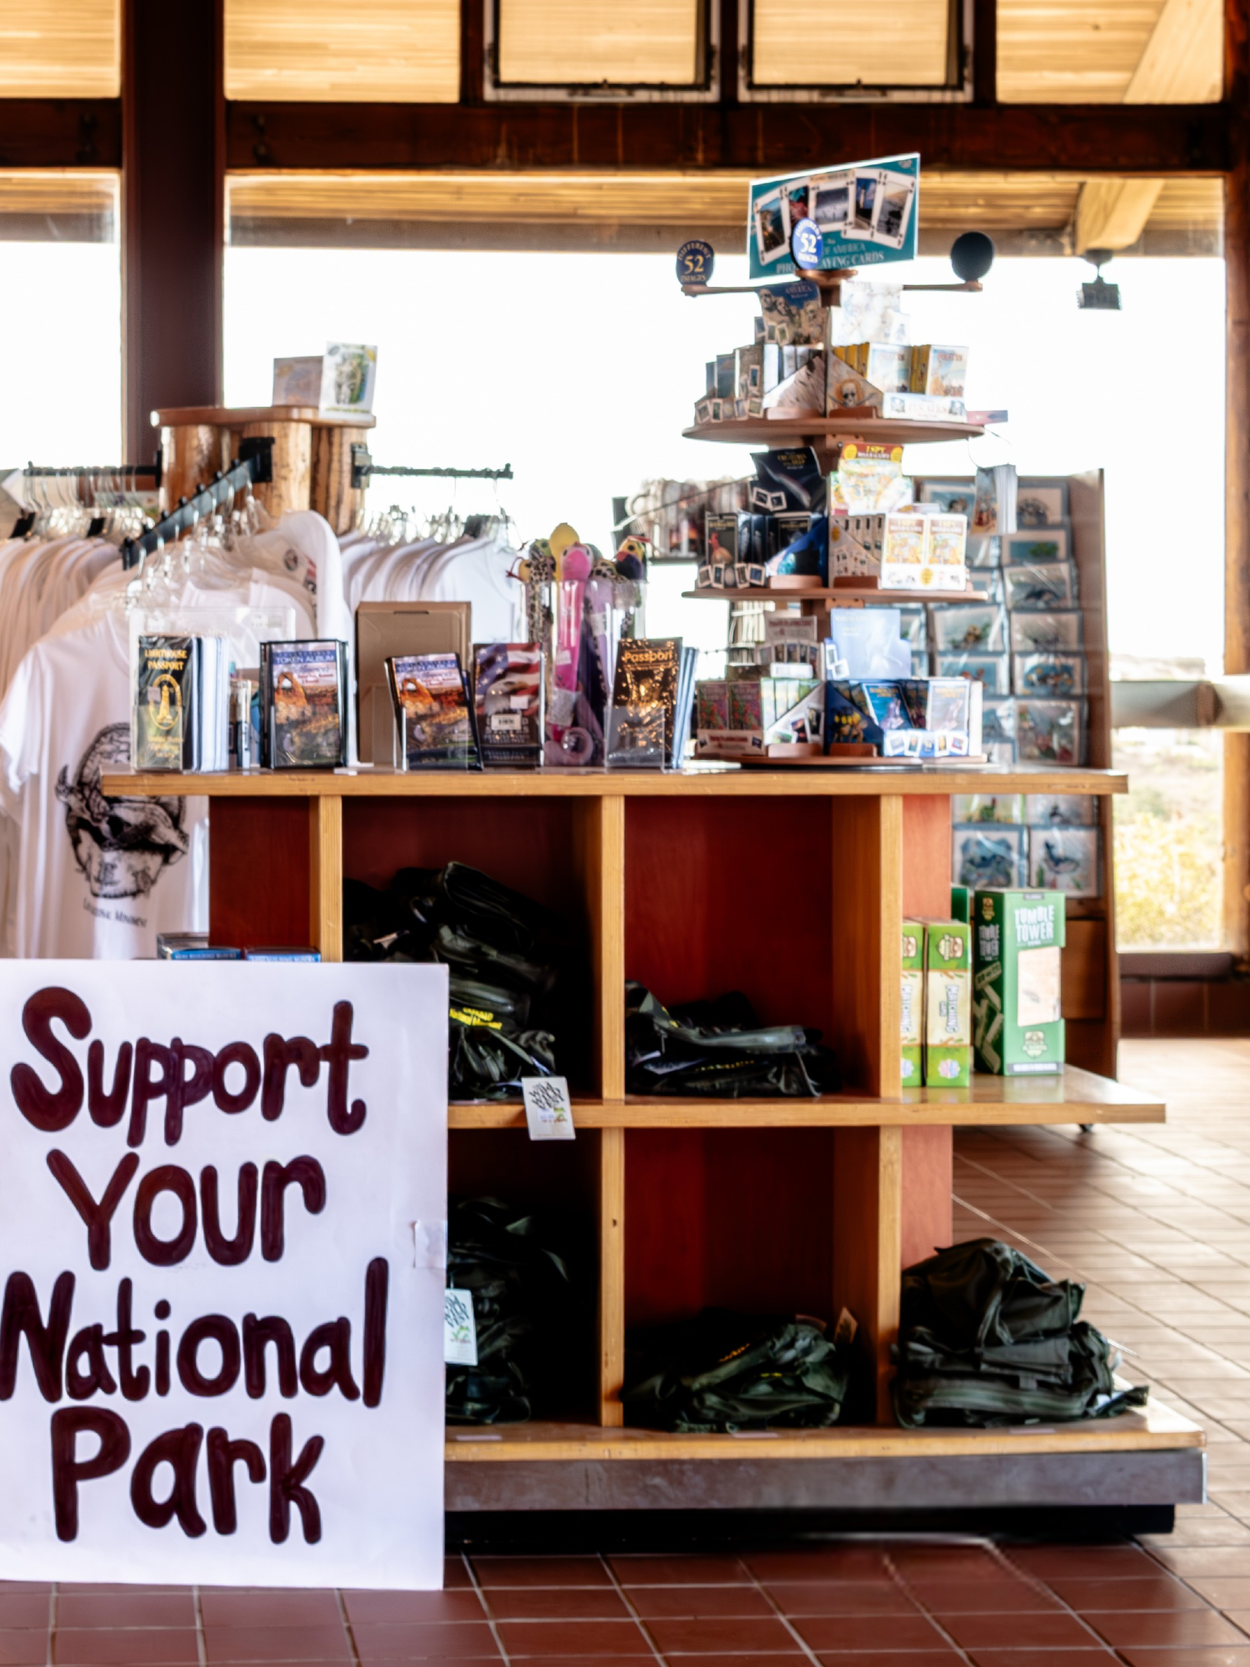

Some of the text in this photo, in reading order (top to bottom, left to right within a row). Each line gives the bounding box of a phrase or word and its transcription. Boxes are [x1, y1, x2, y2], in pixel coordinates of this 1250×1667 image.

[800, 232, 817, 254] 52
[684, 255, 704, 275] 52
[851, 251, 885, 265] CARDS
[147, 661, 184, 671] PASSPORT
[305, 655, 335, 663] ALBUM
[624, 651, 673, 664] Passport
[1014, 904, 1055, 925] TUMBLE
[1016, 921, 1054, 943] TOWER
[10, 986, 370, 1148] Support
[50, 1405, 325, 1544] Park
